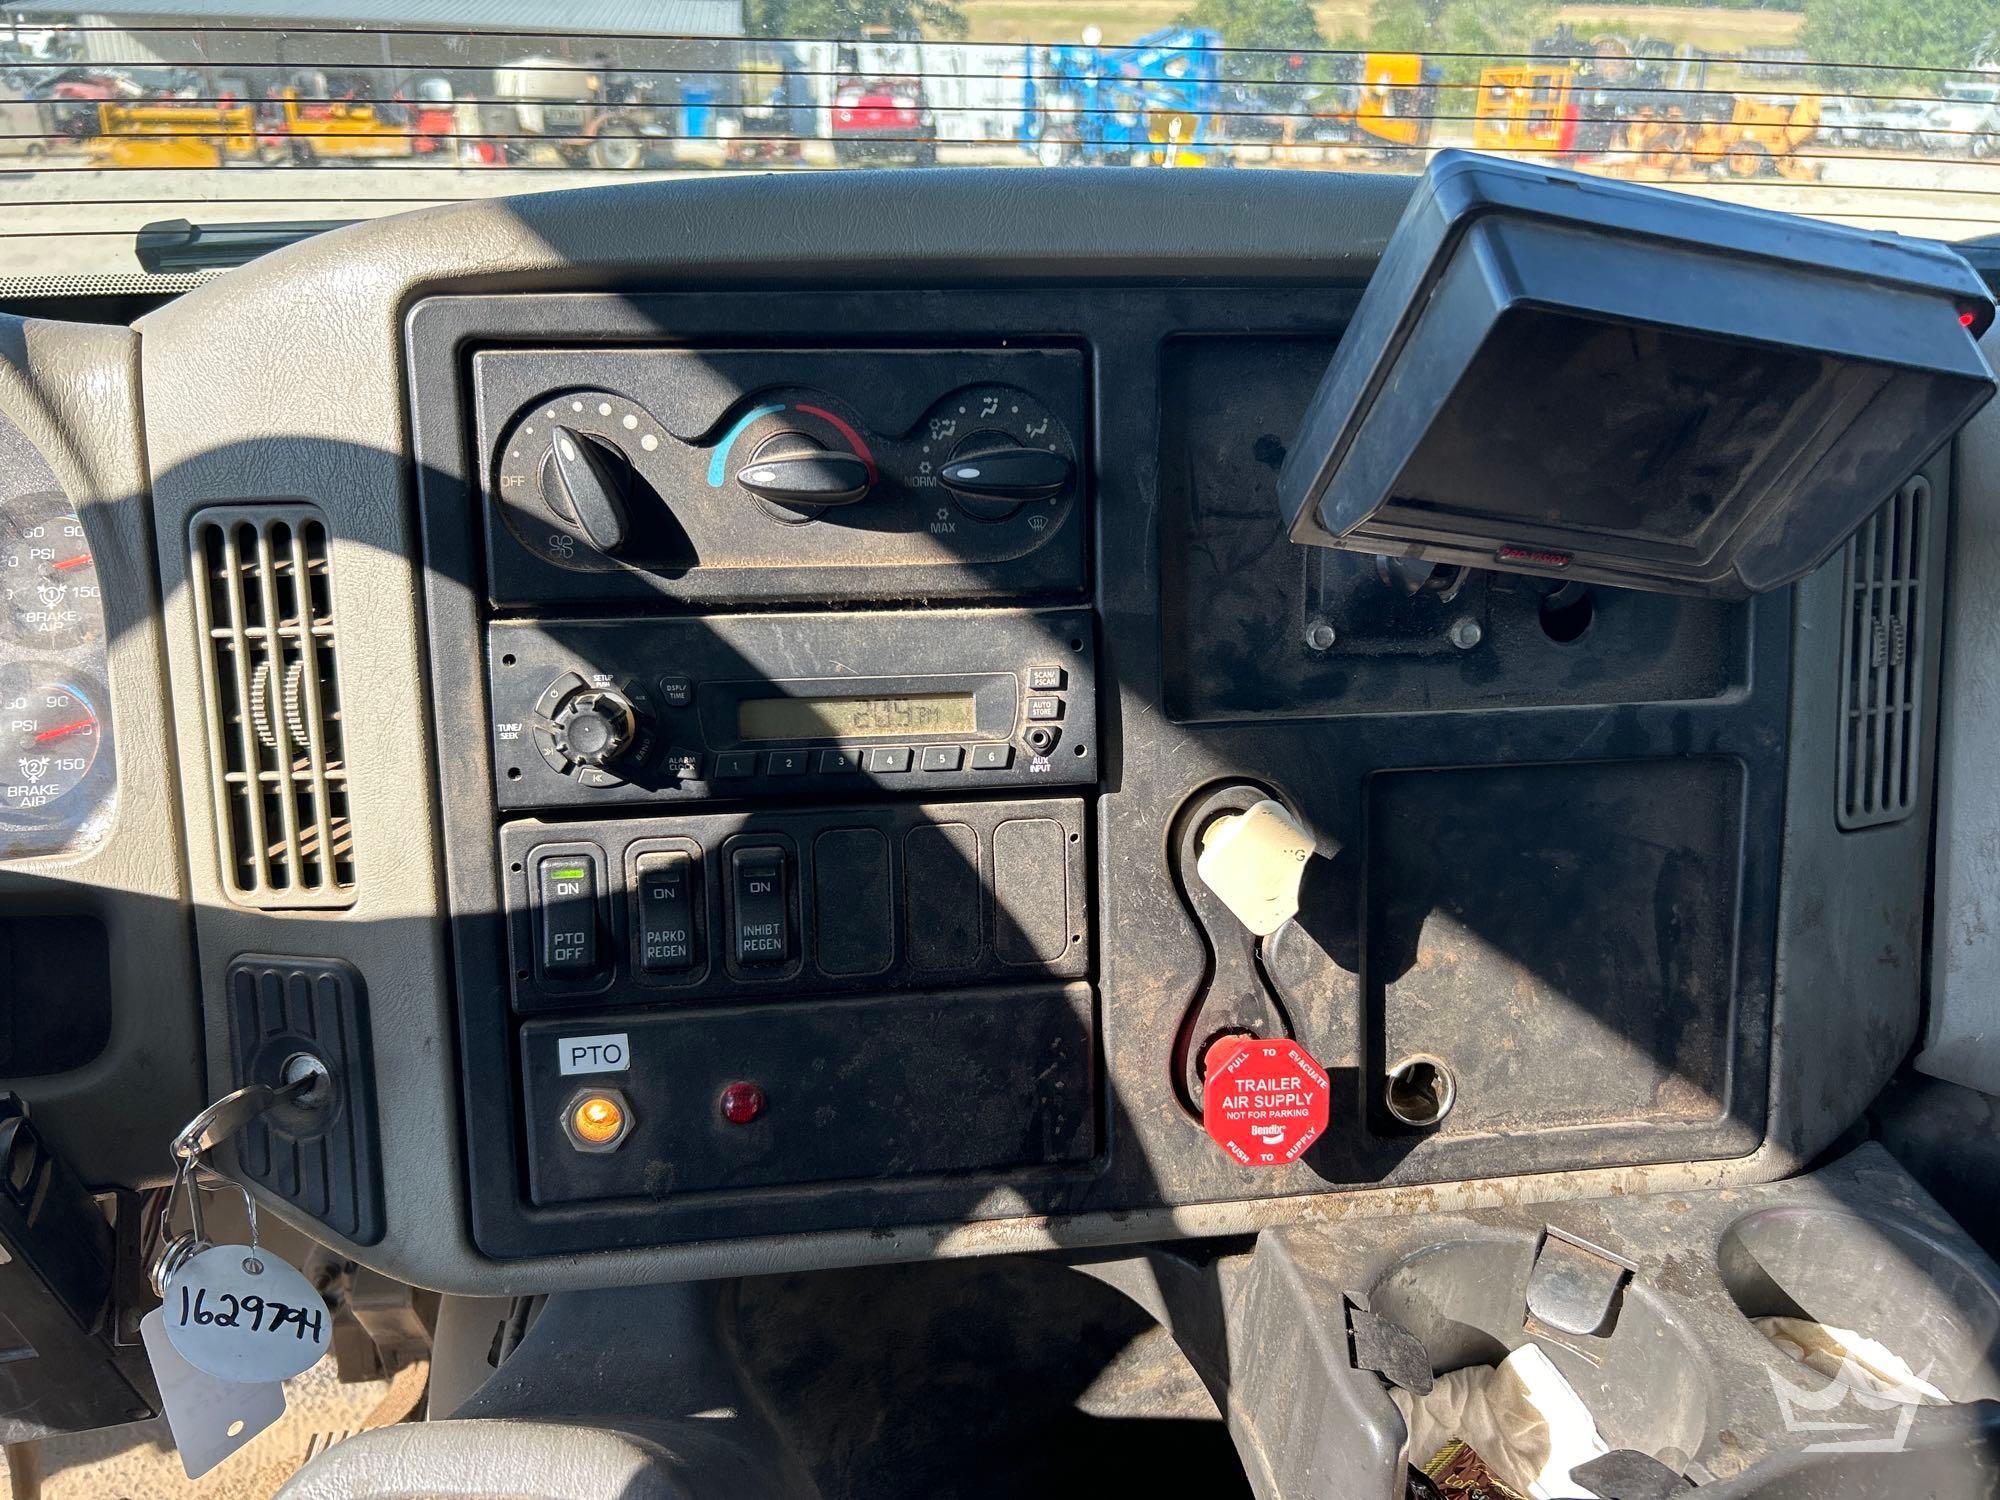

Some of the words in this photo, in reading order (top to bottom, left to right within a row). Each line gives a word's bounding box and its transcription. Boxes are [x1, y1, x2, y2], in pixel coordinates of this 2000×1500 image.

[501, 475, 525, 487] OFF
[904, 476, 937, 488] NORM
[930, 522, 956, 534] MAX
[30, 548, 55, 560] PSI
[72, 586, 101, 598] 150
[26, 611, 77, 622] BRAKE
[593, 674, 614, 682] SETUP
[46, 696, 69, 708] 90
[1032, 701, 1051, 709] AUTO
[1032, 708, 1052, 716] STORE
[11, 720, 38, 732] PSI
[499, 732, 519, 740] SEEK
[668, 756, 696, 764] ALARM
[785, 758, 793, 768] 2
[838, 757, 845, 766] 3
[886, 756, 893, 765] 4
[938, 755, 946, 764] 5
[988, 753, 996, 762] 6
[1032, 757, 1049, 765] AUX
[54, 758, 86, 771] 150
[669, 763, 696, 771] CLOCK
[732, 761, 739, 771] 1
[1029, 764, 1051, 772] INPUT
[7, 784, 60, 798] BRAKE
[20, 796, 47, 808] AIR
[557, 882, 580, 896] ON
[653, 887, 675, 899] ON
[749, 882, 771, 893] ON
[743, 923, 780, 936] INHIBT
[554, 932, 585, 945] PTO
[647, 930, 686, 943] PARKD
[743, 938, 782, 952] REGEN
[555, 947, 585, 961] OFF
[647, 945, 687, 958] REGEN
[572, 1043, 622, 1067] PTO
[1227, 1052, 1250, 1073] PULL
[1262, 1048, 1277, 1057] TO
[1287, 1049, 1329, 1090] EVACUATE
[1235, 1076, 1301, 1093] TRAILER
[1222, 1095, 1249, 1109] AIR
[1254, 1092, 1314, 1108] SUPPLY
[1226, 1111, 1246, 1120] NOT
[1247, 1110, 1267, 1119] FOR
[1268, 1108, 1309, 1118] PARKING
[1226, 1140, 1250, 1163] PUSH
[1260, 1153, 1274, 1161] TO
[1285, 1126, 1316, 1159] SUPPLY
